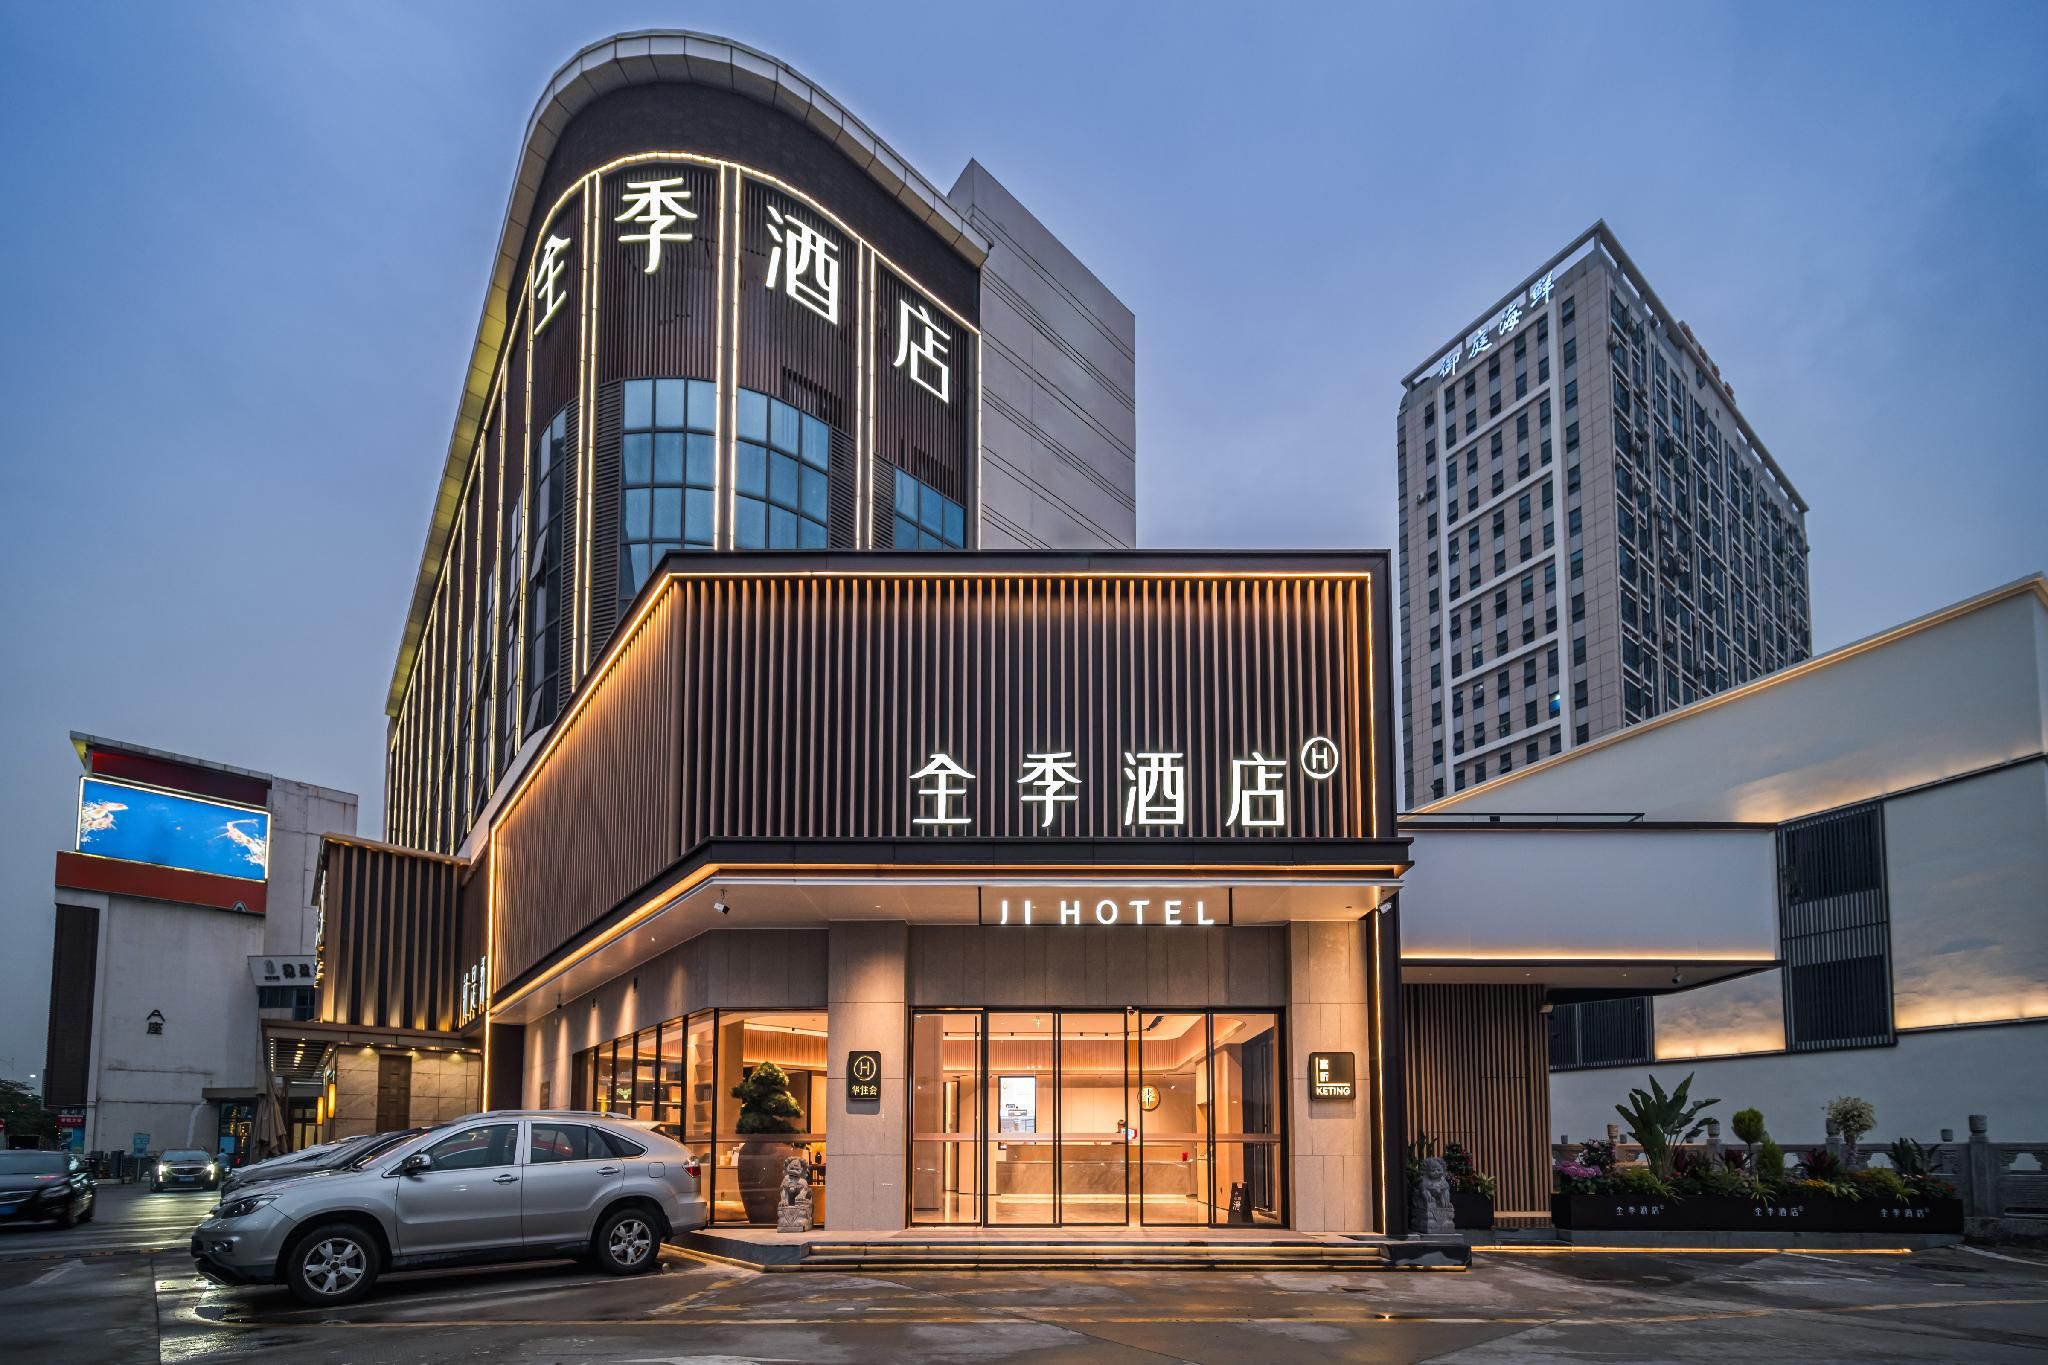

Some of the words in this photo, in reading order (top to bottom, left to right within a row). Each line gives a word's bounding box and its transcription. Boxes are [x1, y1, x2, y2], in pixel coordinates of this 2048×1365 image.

[534, 176, 950, 404] 全季酒店
[908, 751, 1287, 828] 全季酒店
[1000, 899, 1032, 925] JI
[1060, 899, 1215, 925] HOTEL
[851, 1085, 878, 1096] 华住会
[1316, 1087, 1351, 1096] KETING
